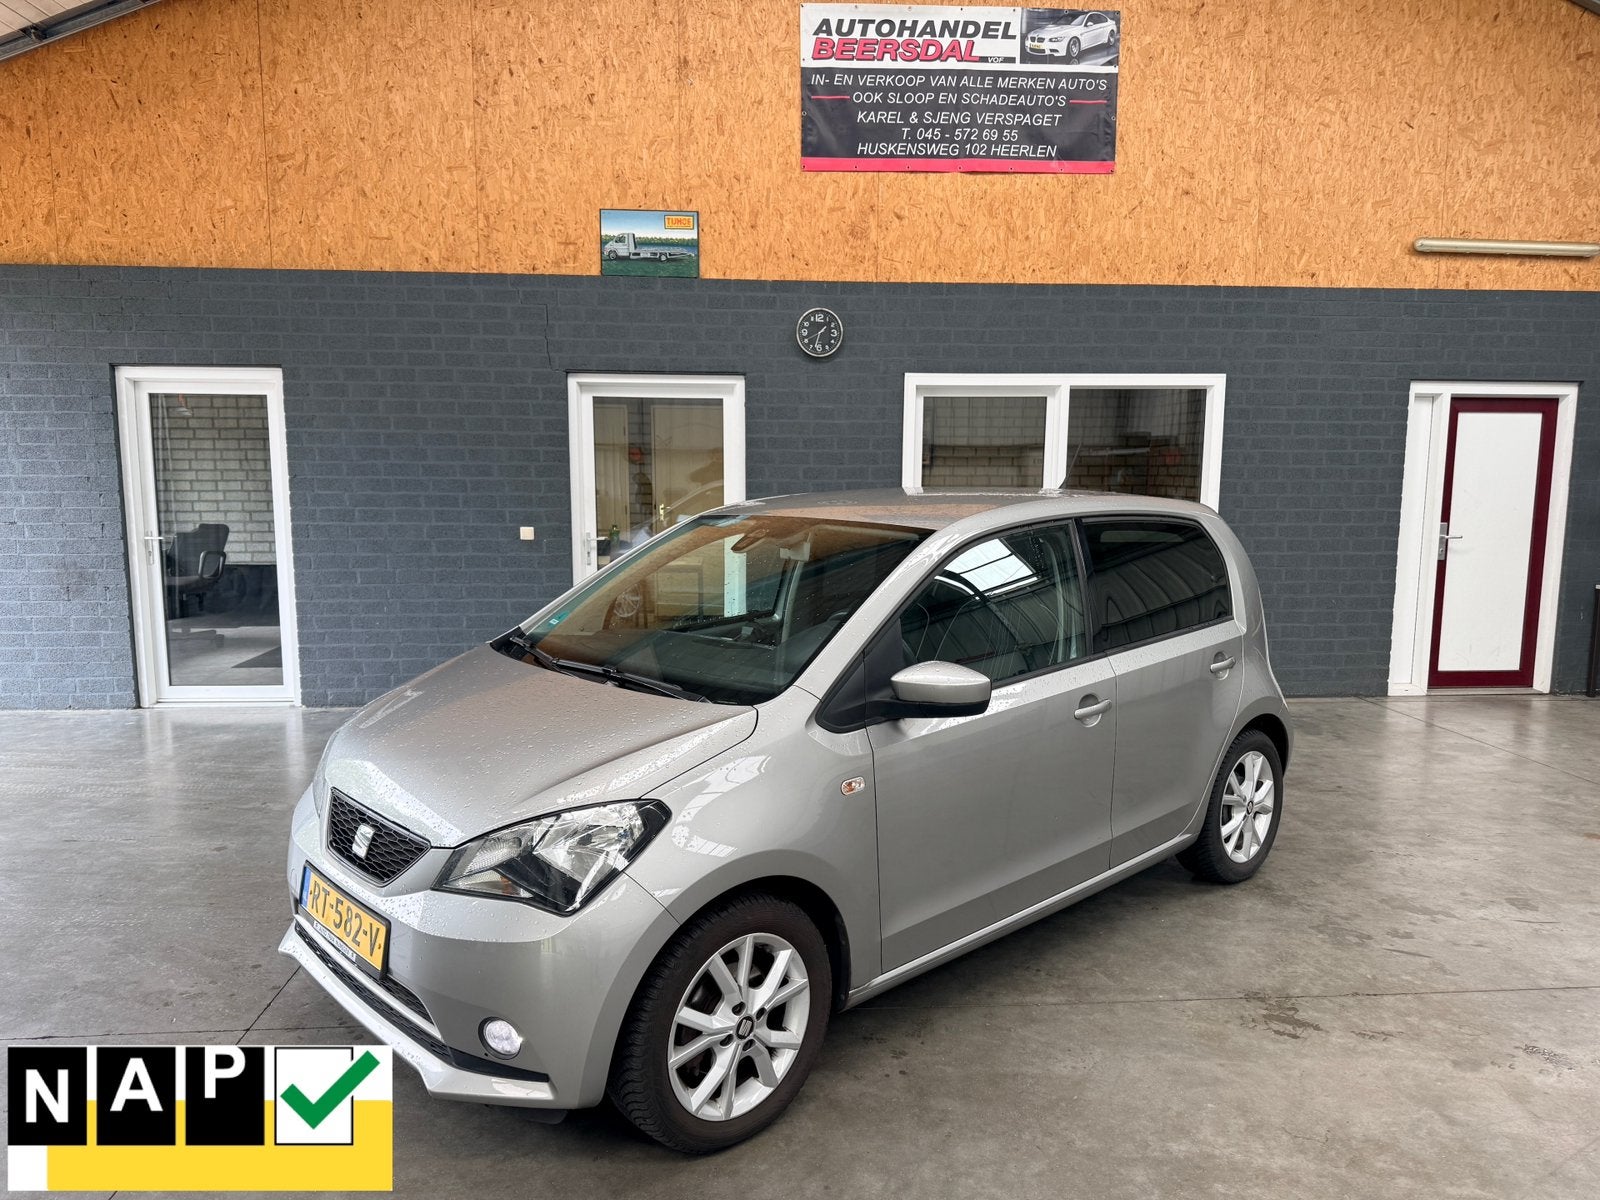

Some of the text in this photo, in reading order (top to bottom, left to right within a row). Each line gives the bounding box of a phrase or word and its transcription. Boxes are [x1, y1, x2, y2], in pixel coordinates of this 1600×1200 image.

[812, 18, 1017, 39] AUTOHANDEL
[812, 37, 980, 62] BEERSDAL
[811, 74, 1108, 91] IN- EN VERKOOP VAN ALLE MERKEN AUTO'S
[852, 92, 1067, 107] OOK SLOOP EN SCHADEAUTO'S
[857, 111, 1063, 126] KAREL & SJENG VERSPAGET
[901, 128, 912, 140] T.
[916, 128, 941, 140] 045
[953, 129, 979, 141] 572
[982, 130, 999, 141] 69
[1002, 130, 1019, 141] 55
[857, 143, 1058, 157] HUSKENSWEG 102 HEERLEN
[815, 313, 824, 322] 12
[801, 328, 808, 337] 9
[830, 329, 838, 337] 3
[311, 880, 380, 957] RT-582-V
